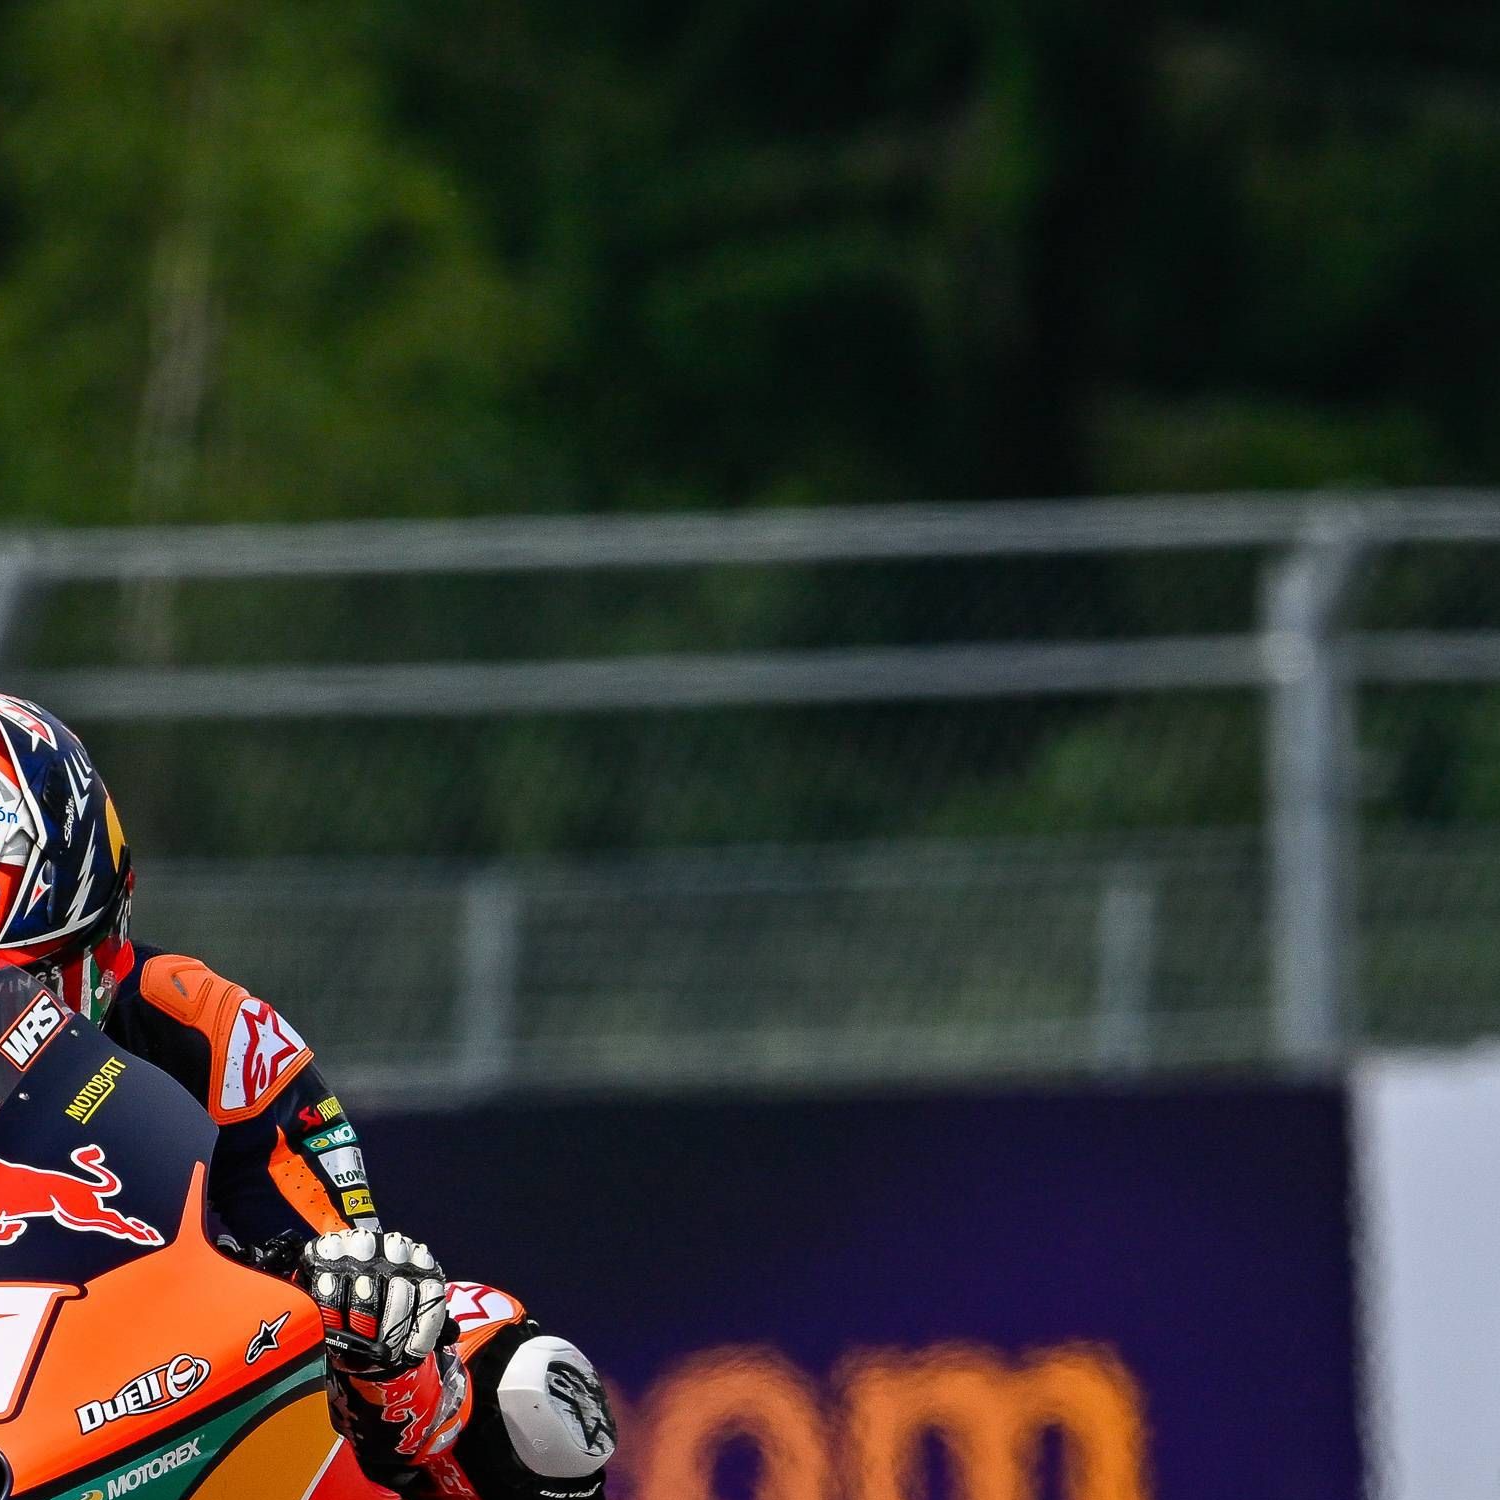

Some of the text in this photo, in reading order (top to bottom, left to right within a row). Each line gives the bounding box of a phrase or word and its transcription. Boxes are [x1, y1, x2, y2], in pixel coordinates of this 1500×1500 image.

[1, 994, 60, 1067] WRS
[65, 1056, 126, 1123] MOTOBATT
[106, 1437, 202, 1500] MOTOREX
